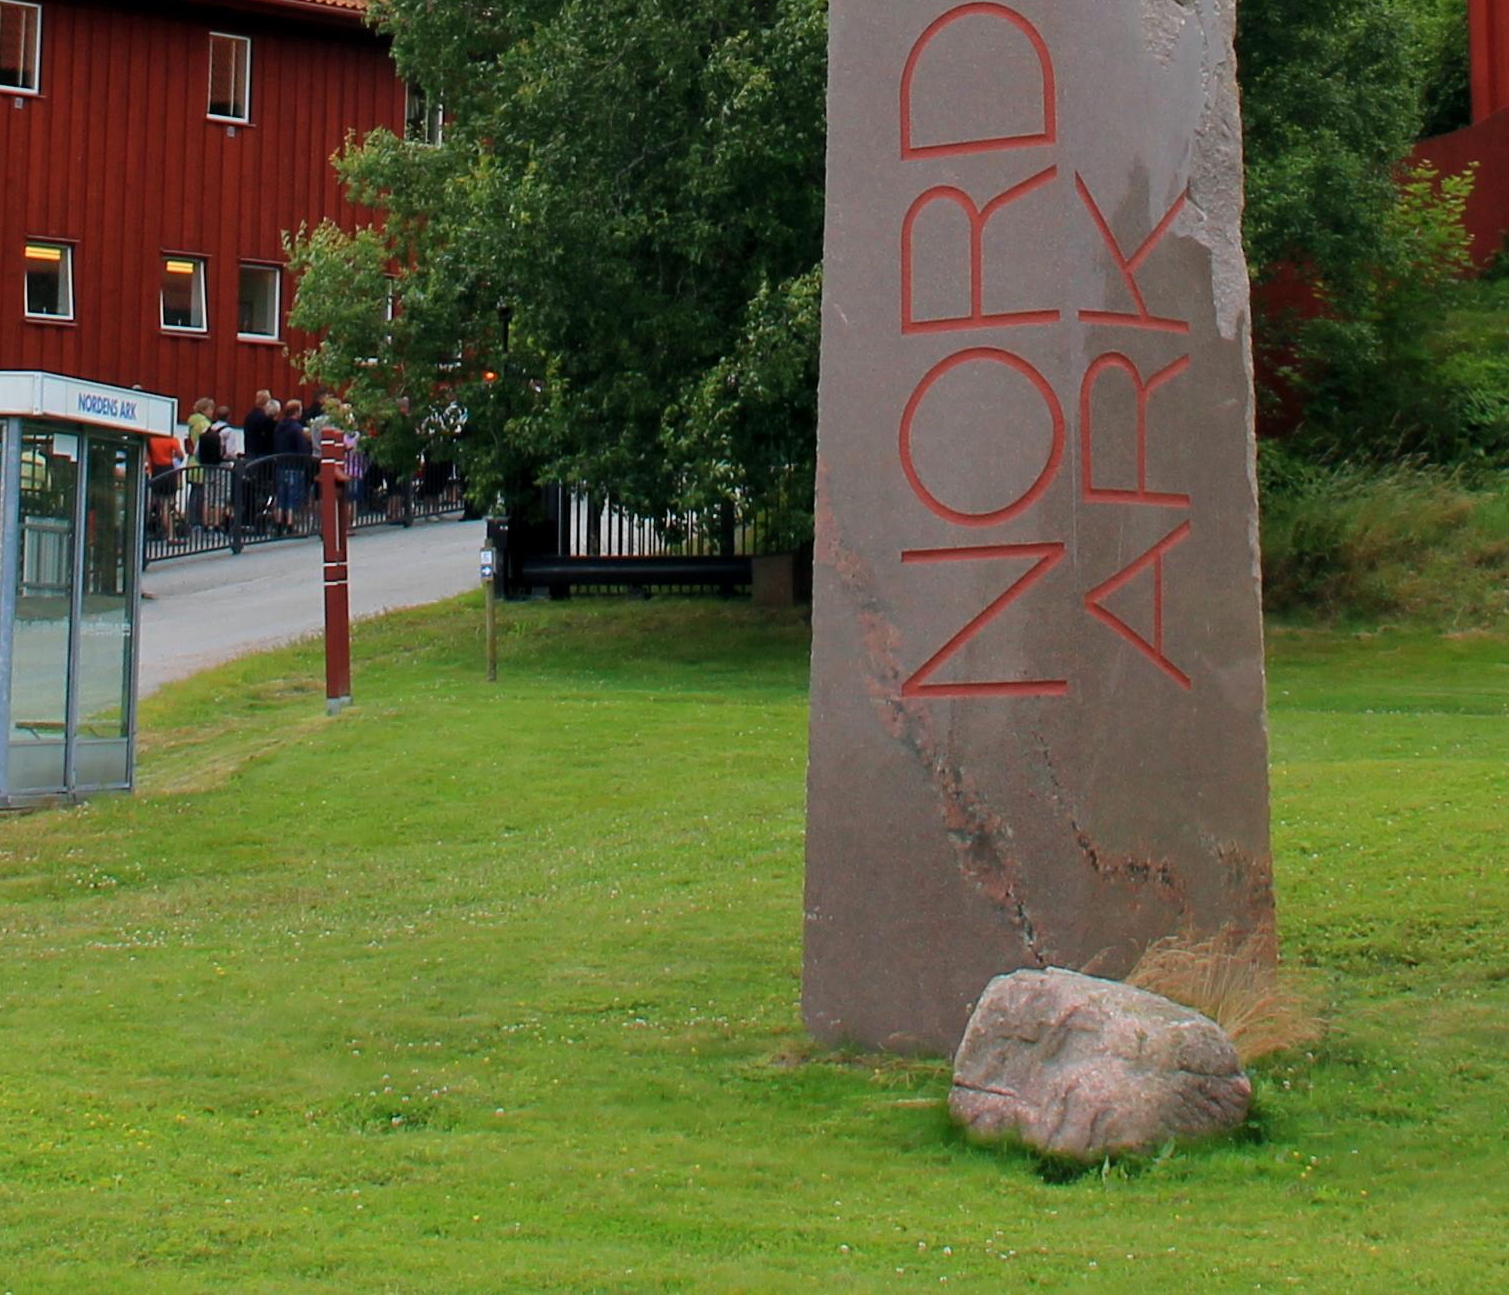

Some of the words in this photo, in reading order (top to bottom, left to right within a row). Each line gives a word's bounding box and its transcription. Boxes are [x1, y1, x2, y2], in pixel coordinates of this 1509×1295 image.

[78, 392, 118, 417] NORDENS
[120, 401, 138, 420] ARK
[1075, 169, 1192, 691] ARK
